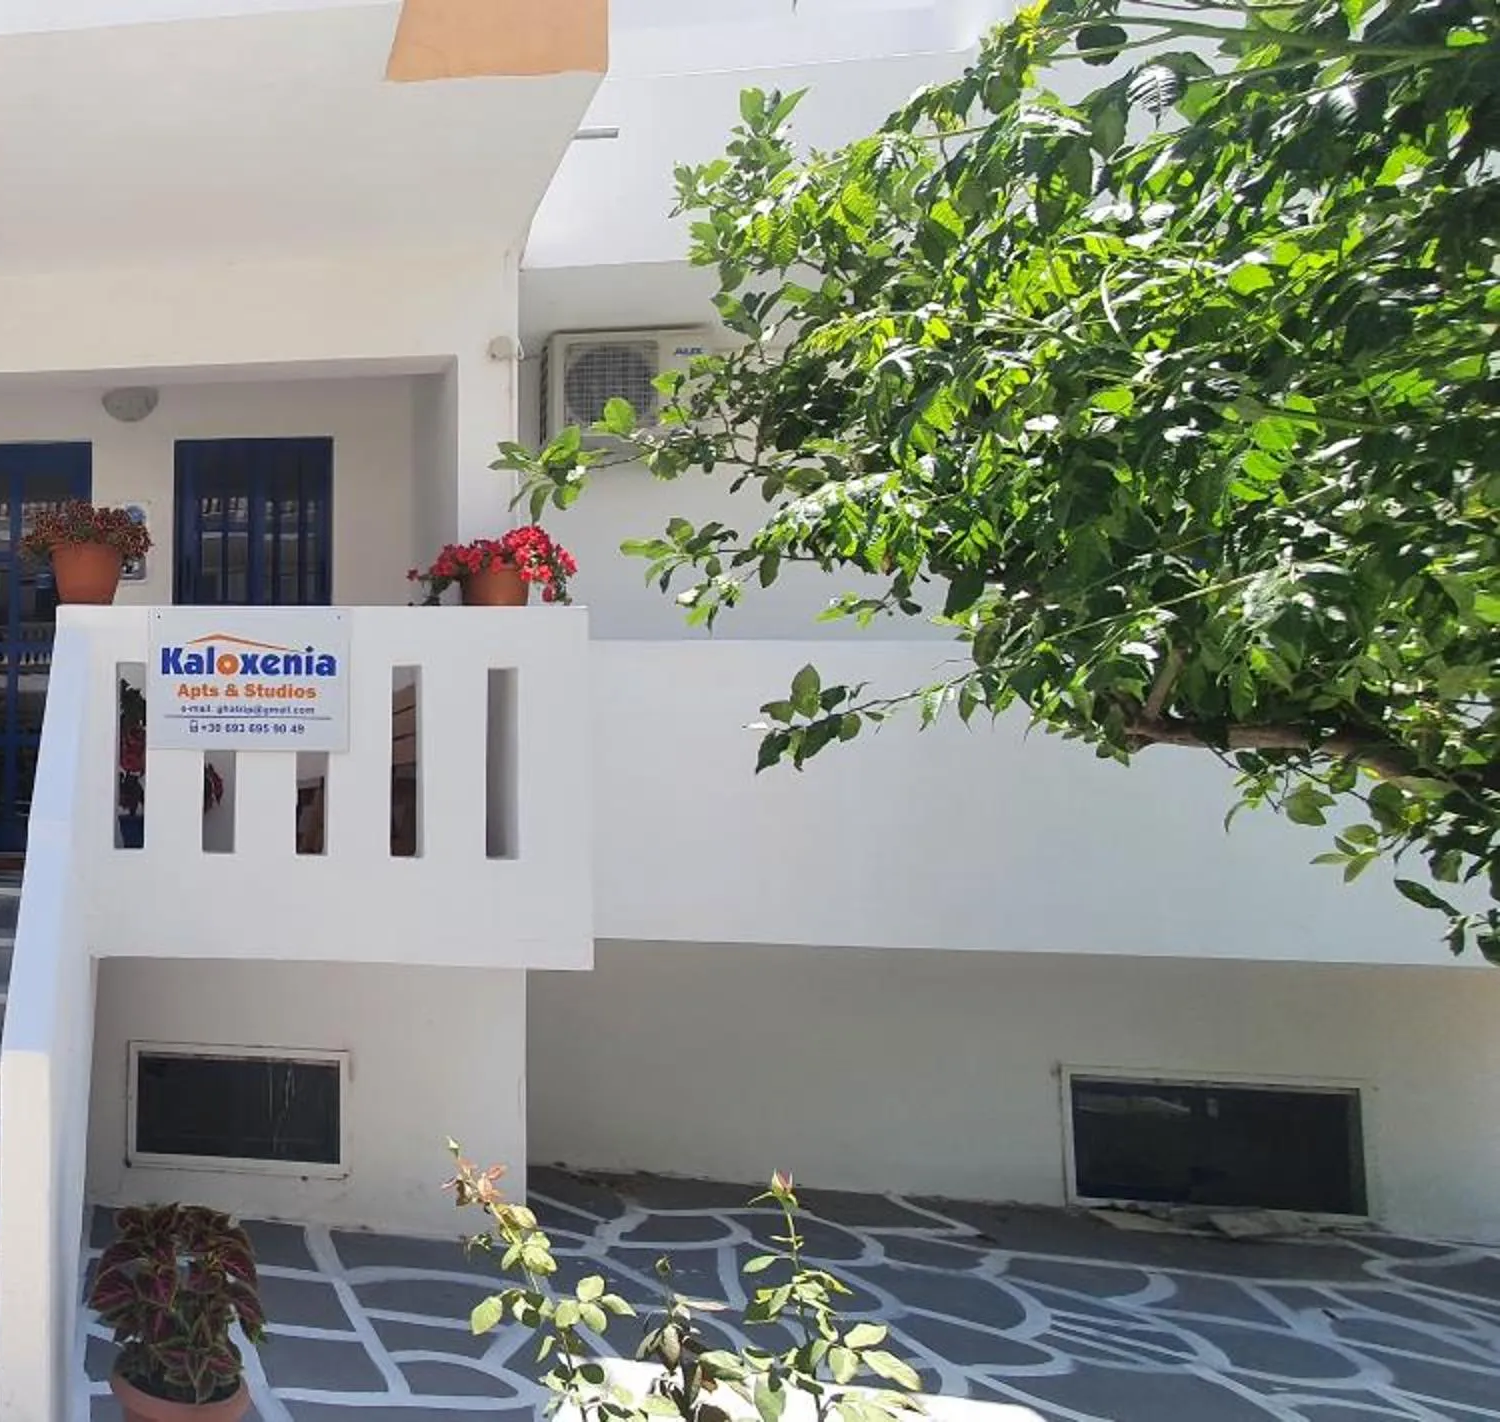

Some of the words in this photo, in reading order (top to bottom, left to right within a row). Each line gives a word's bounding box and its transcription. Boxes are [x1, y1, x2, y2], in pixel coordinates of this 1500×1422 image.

[161, 645, 337, 676] Kaloxenia
[178, 683, 219, 700] Apts
[225, 683, 239, 698] &
[244, 683, 317, 699] Studios
